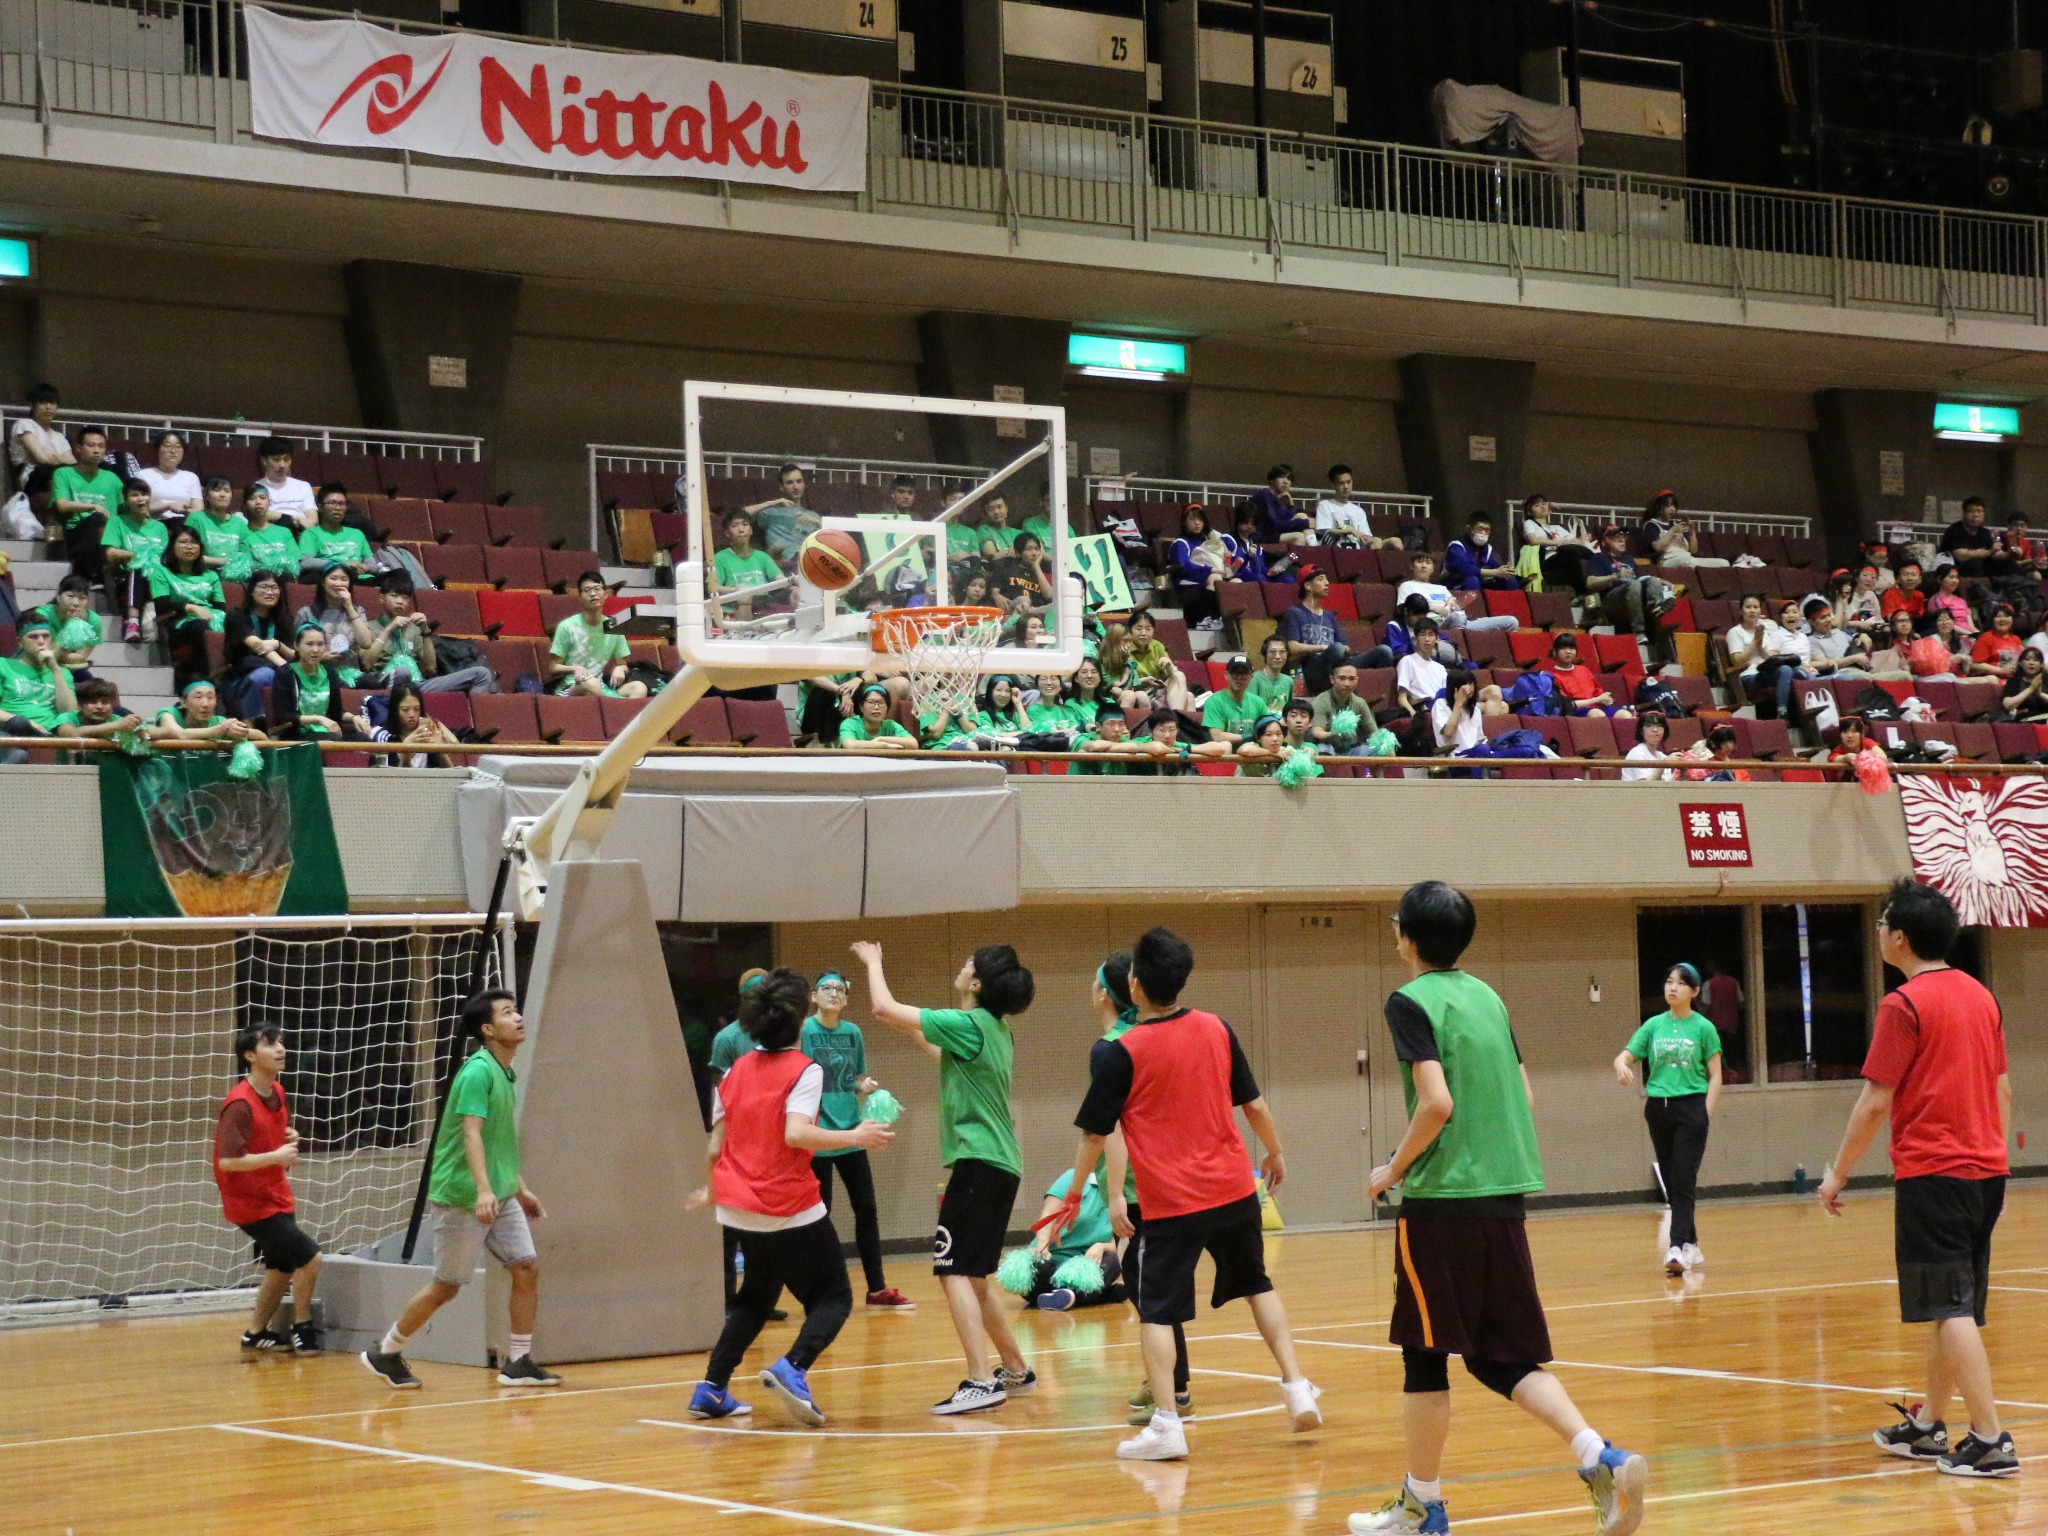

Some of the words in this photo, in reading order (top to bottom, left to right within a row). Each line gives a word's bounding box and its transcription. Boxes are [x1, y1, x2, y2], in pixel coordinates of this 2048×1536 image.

[859, 2, 875, 29] 24
[1111, 36, 1128, 61] 25
[1302, 66, 1318, 90] 26
[480, 56, 808, 174] Nittaku
[1688, 810, 1743, 839] 禁煙
[1690, 849, 1705, 861] NO
[1706, 849, 1748, 861] SMOKING
